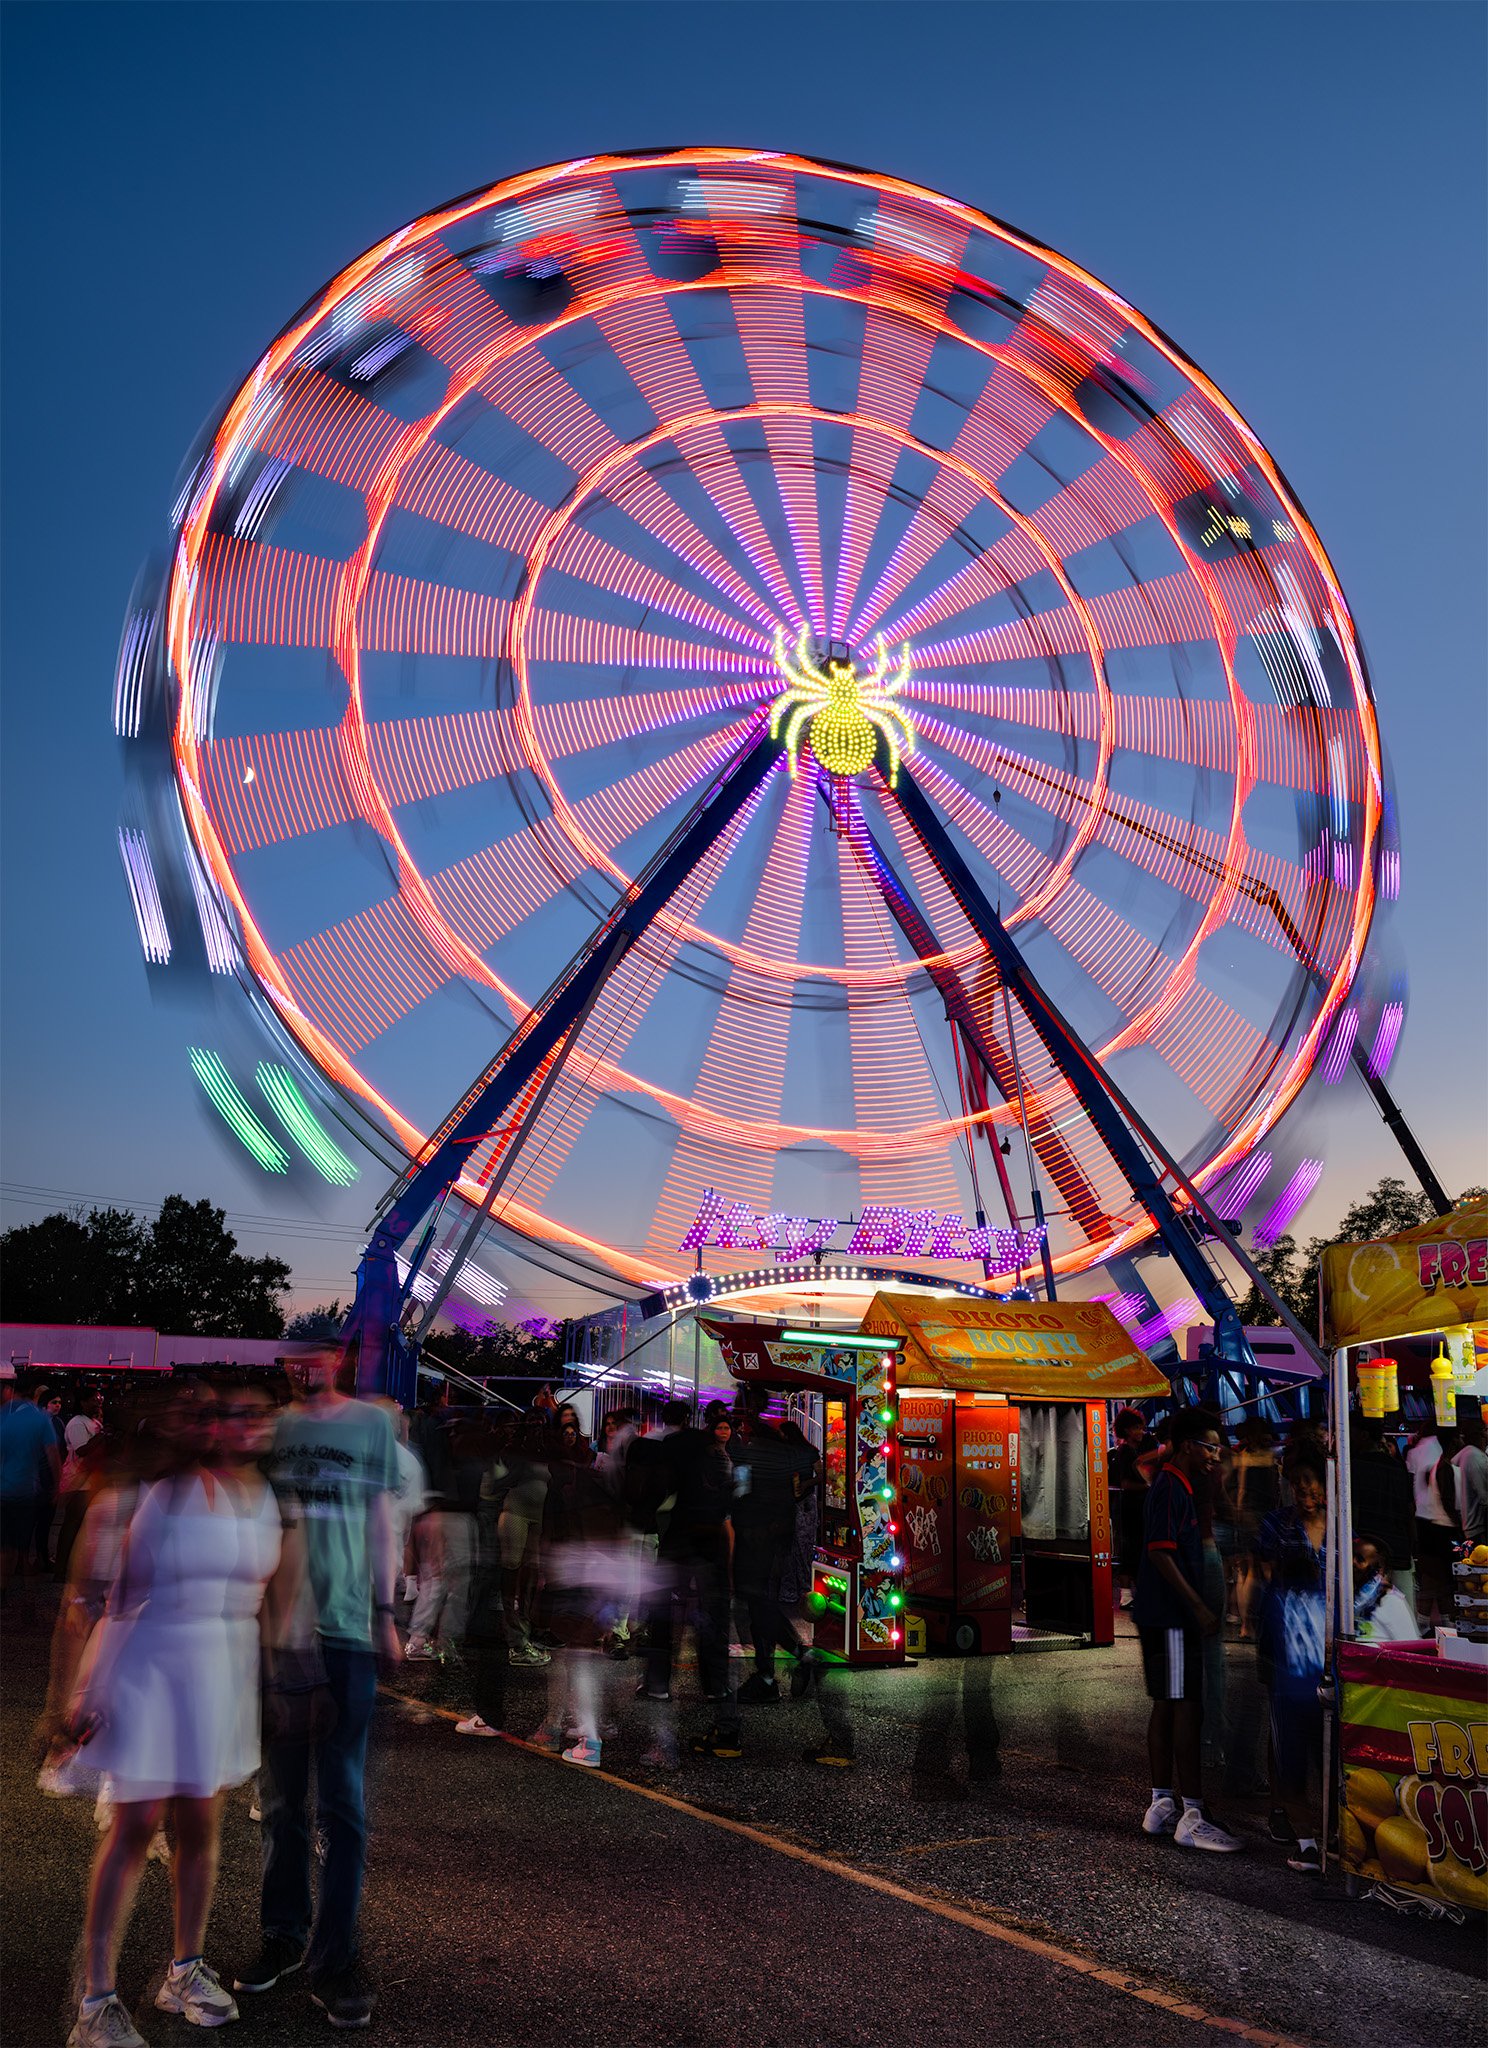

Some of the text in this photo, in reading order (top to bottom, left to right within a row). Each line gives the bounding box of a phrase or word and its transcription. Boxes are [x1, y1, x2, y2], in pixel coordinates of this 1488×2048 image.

[678, 1189, 1049, 1274] Itsy Bitsy
[863, 1319, 900, 1336] PHOTO
[947, 1309, 1065, 1330] PHOTO
[966, 1329, 1088, 1356] BOOTH
[903, 1401, 942, 1417] PHOTO
[902, 1417, 943, 1433] BOOTH
[963, 1431, 1003, 1443] PHOTO
[312, 1444, 354, 1469] JONES
[962, 1444, 1003, 1457] BOOTH
[1092, 1410, 1105, 1540] BOOTH PHOTO
